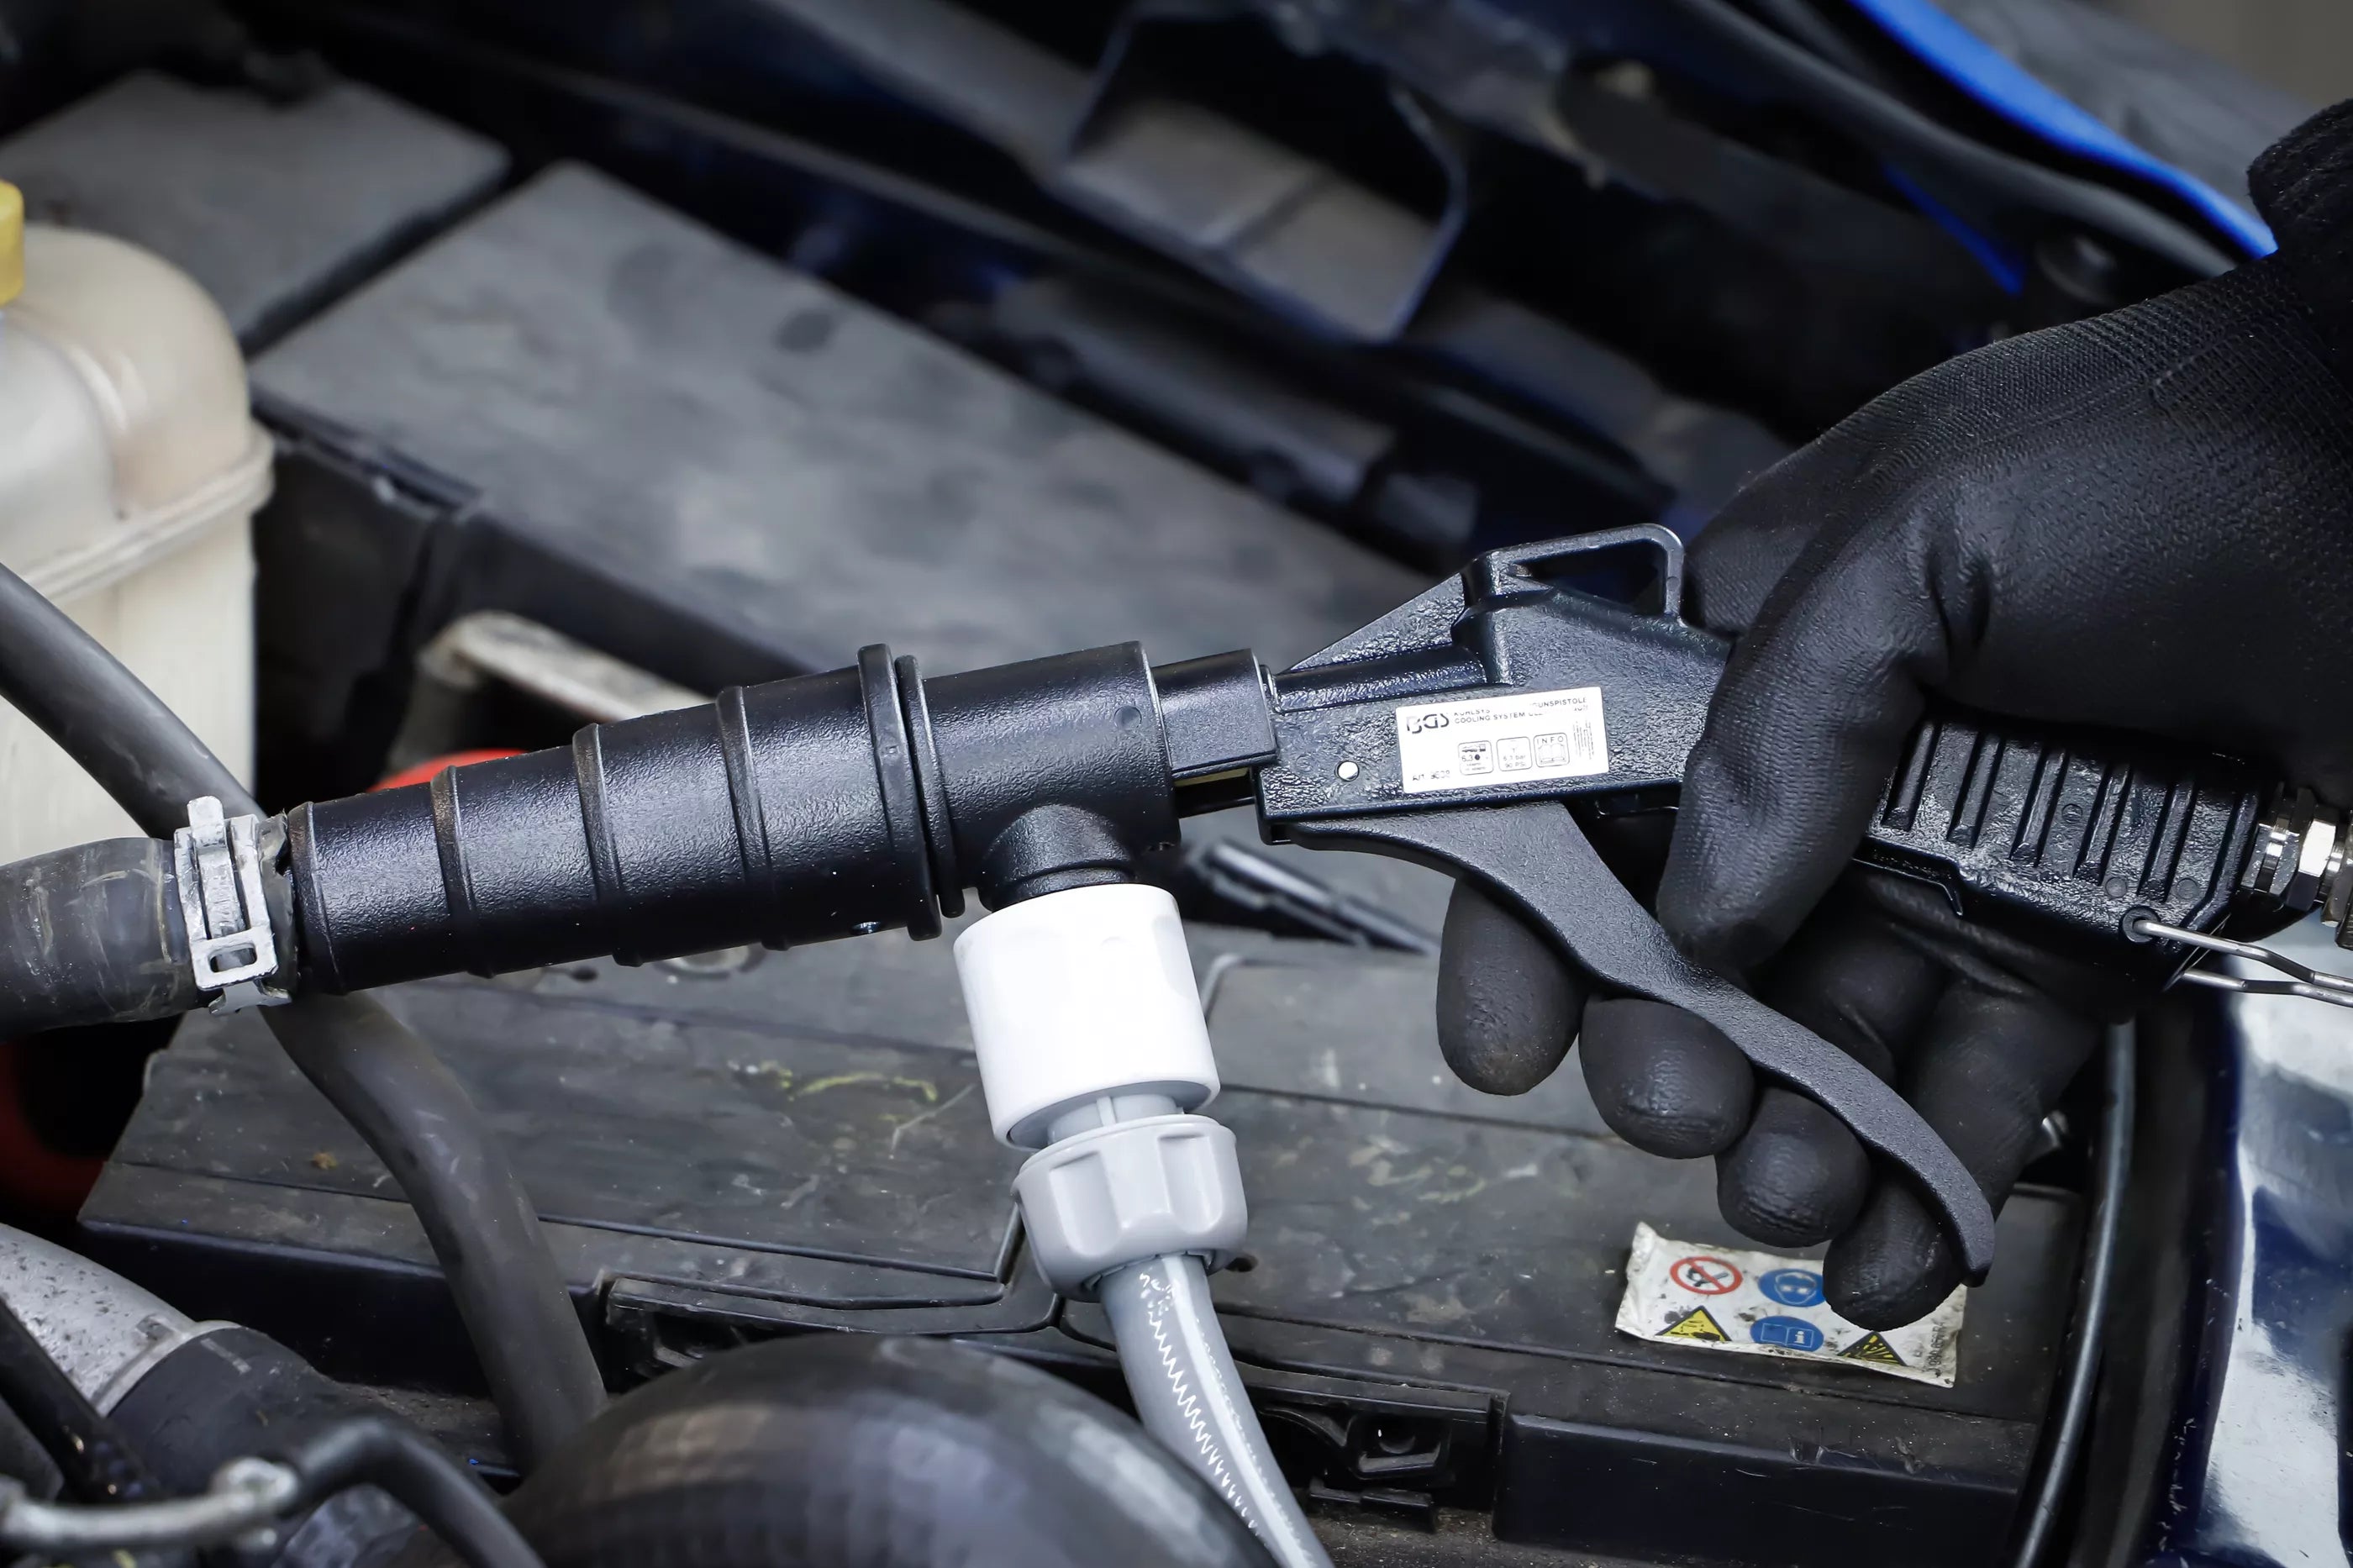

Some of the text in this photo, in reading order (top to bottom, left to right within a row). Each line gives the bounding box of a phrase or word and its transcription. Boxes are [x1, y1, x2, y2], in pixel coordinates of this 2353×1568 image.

[1454, 715, 1491, 724] COOLING
[1493, 712, 1526, 721] SYSTEM
[1536, 735, 1564, 745] INFO
